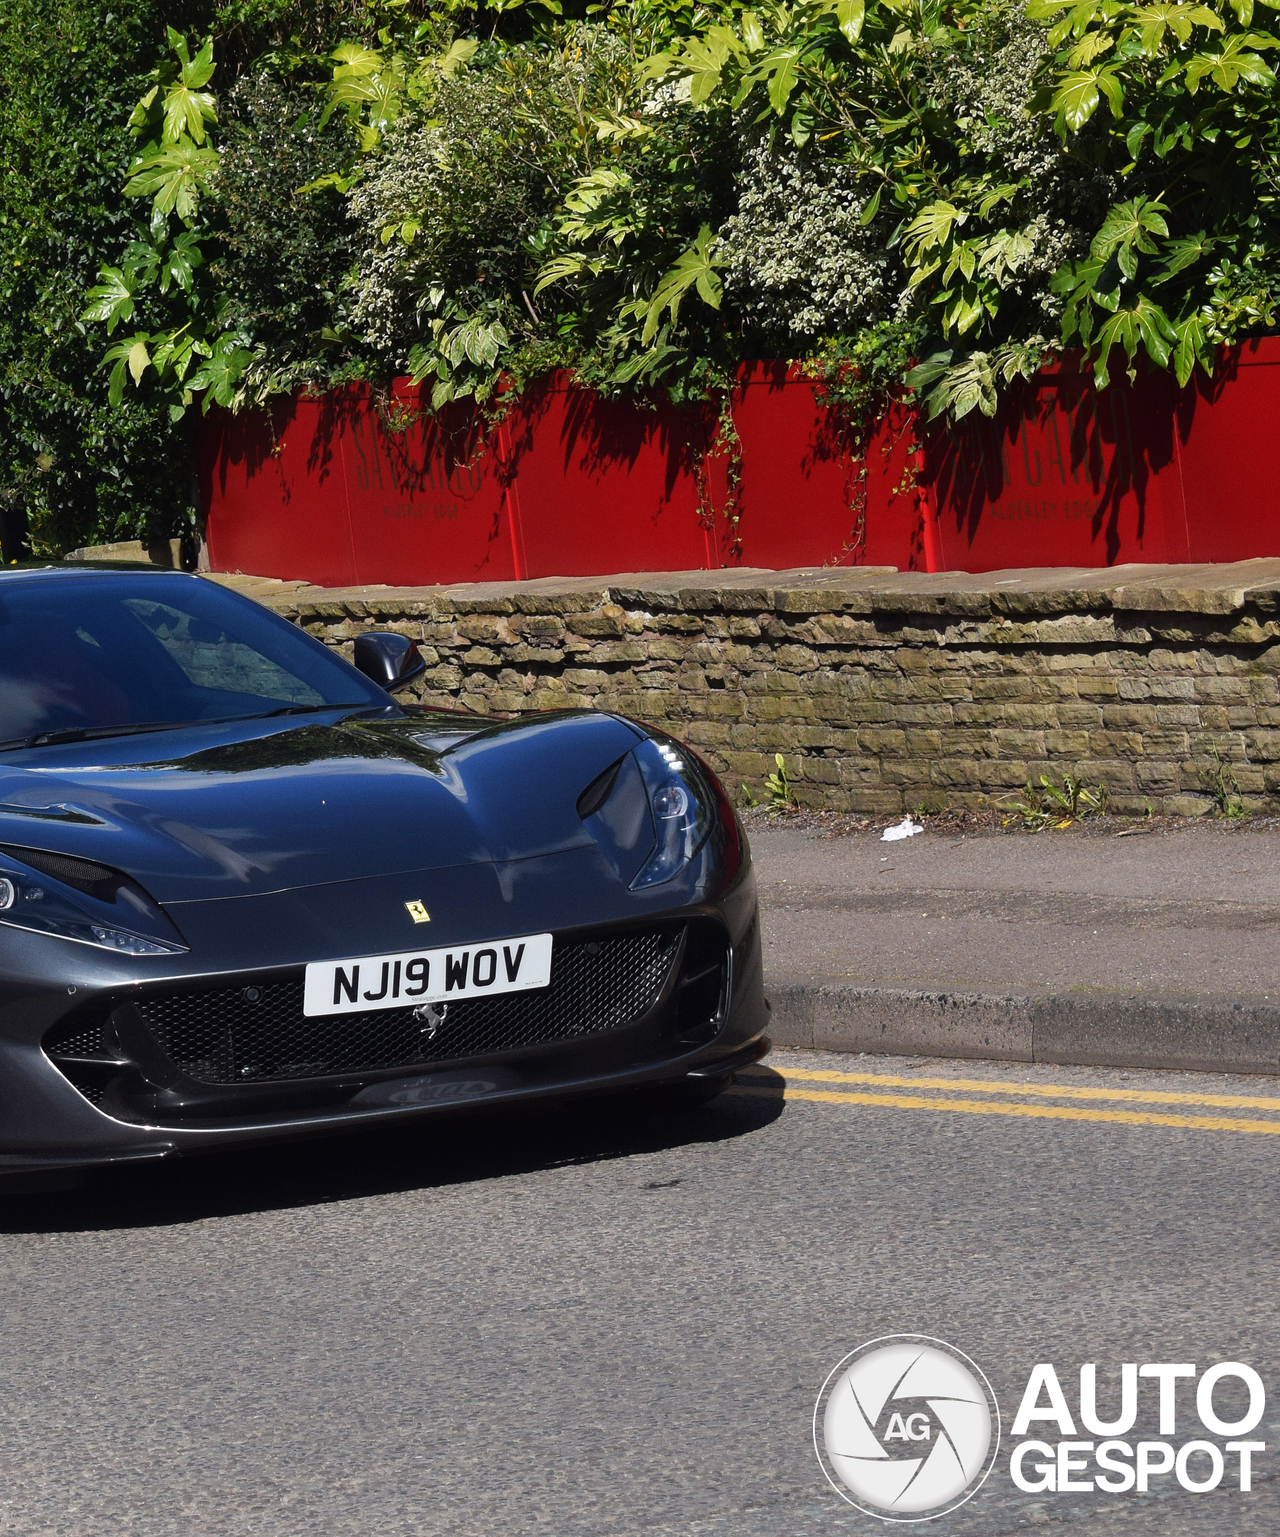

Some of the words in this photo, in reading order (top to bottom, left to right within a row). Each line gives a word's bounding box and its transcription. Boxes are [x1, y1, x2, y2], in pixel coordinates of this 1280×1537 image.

[990, 501, 1058, 520] ALDERLEY
[1064, 500, 1103, 519] EDGE
[332, 957, 430, 1005] NJ19
[445, 943, 525, 992] WOV
